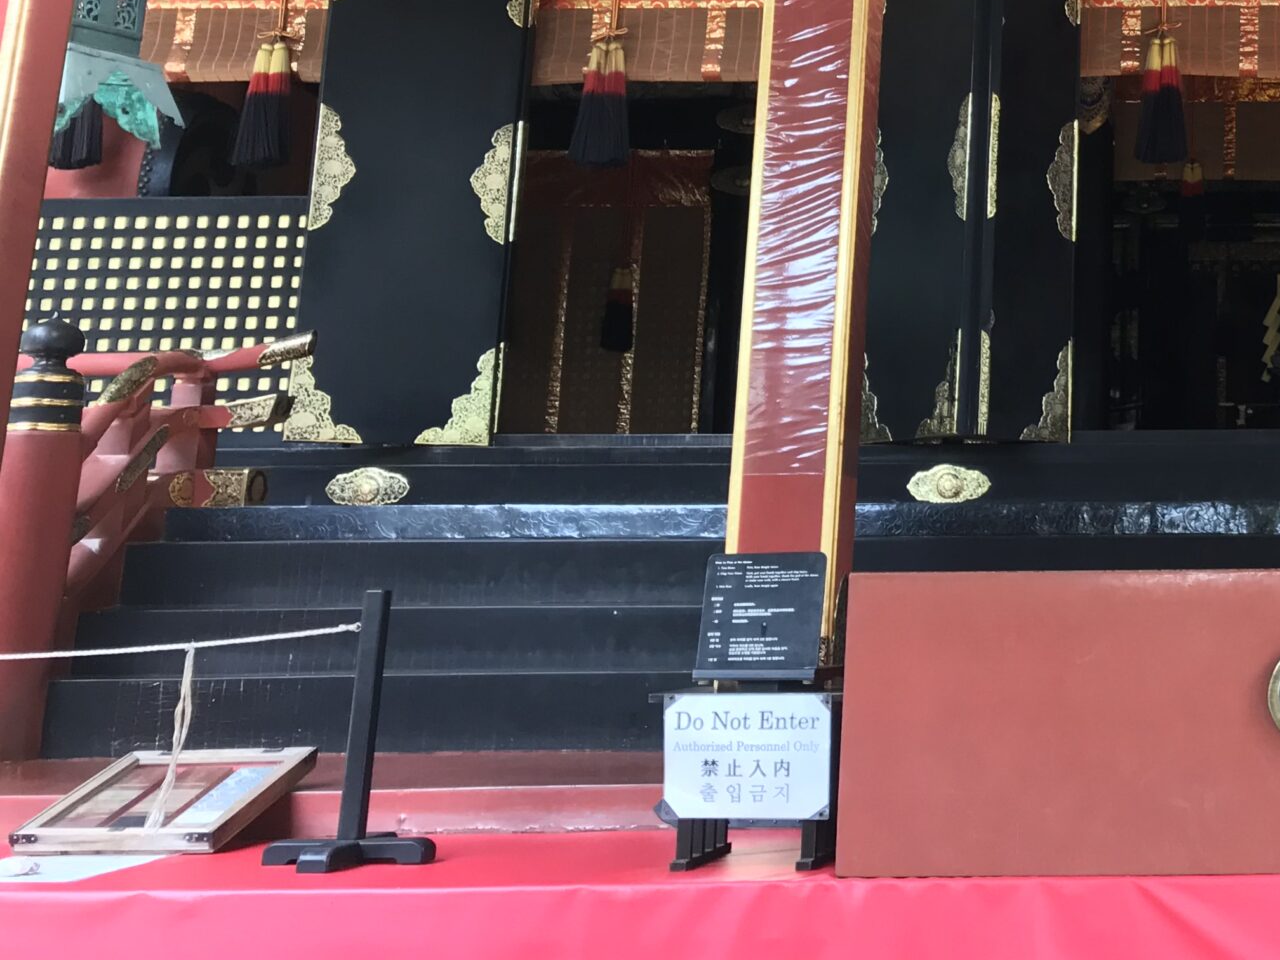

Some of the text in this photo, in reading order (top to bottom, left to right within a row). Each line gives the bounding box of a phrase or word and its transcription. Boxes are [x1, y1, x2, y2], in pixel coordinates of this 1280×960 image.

[674, 711, 820, 731] Do Not Enter
[673, 740, 820, 754] Authorized Personnel Only
[700, 758, 791, 778] 禁止入内
[699, 783, 790, 803] 출입금지
